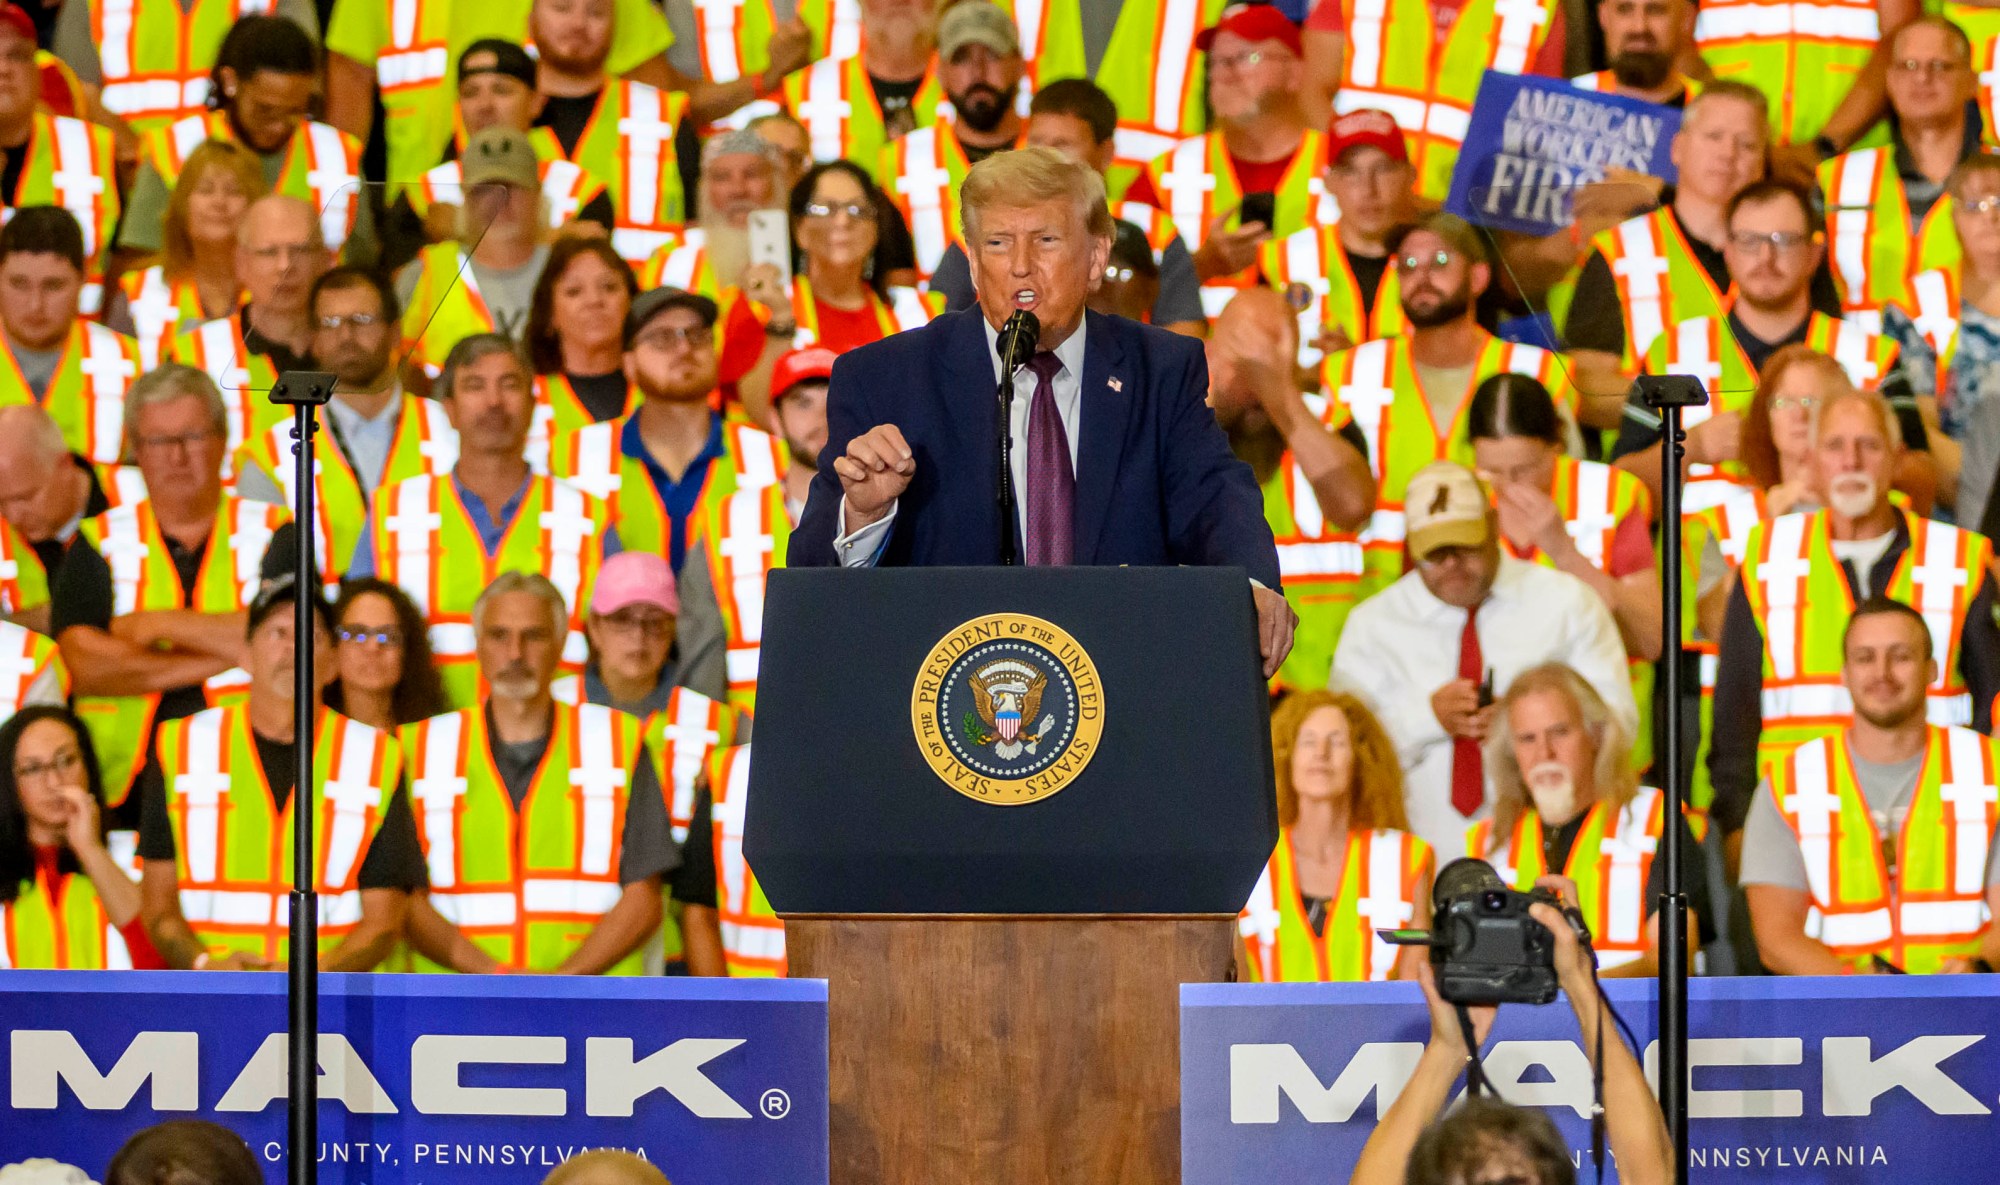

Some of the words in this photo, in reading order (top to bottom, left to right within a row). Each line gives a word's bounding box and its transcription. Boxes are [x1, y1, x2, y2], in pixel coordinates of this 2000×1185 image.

[1508, 87, 1663, 147] AMERICAN
[1503, 118, 1653, 174] WORKERS
[1483, 153, 1605, 227] FIR
[1009, 622, 1027, 635] OF
[1031, 626, 1055, 645] THE
[919, 620, 1004, 705] PRESIDENT
[1059, 642, 1098, 720] UNITED
[921, 711, 935, 738] THE
[928, 741, 943, 757] OF
[942, 753, 991, 795] SEAL
[1025, 738, 1090, 796] STATES
[11, 1029, 753, 1119] MACK
[1230, 1034, 1992, 1124] MACK
[264, 1141, 399, 1166] CUNTY,
[1690, 1145, 1888, 1168] NNSYLVANIA
